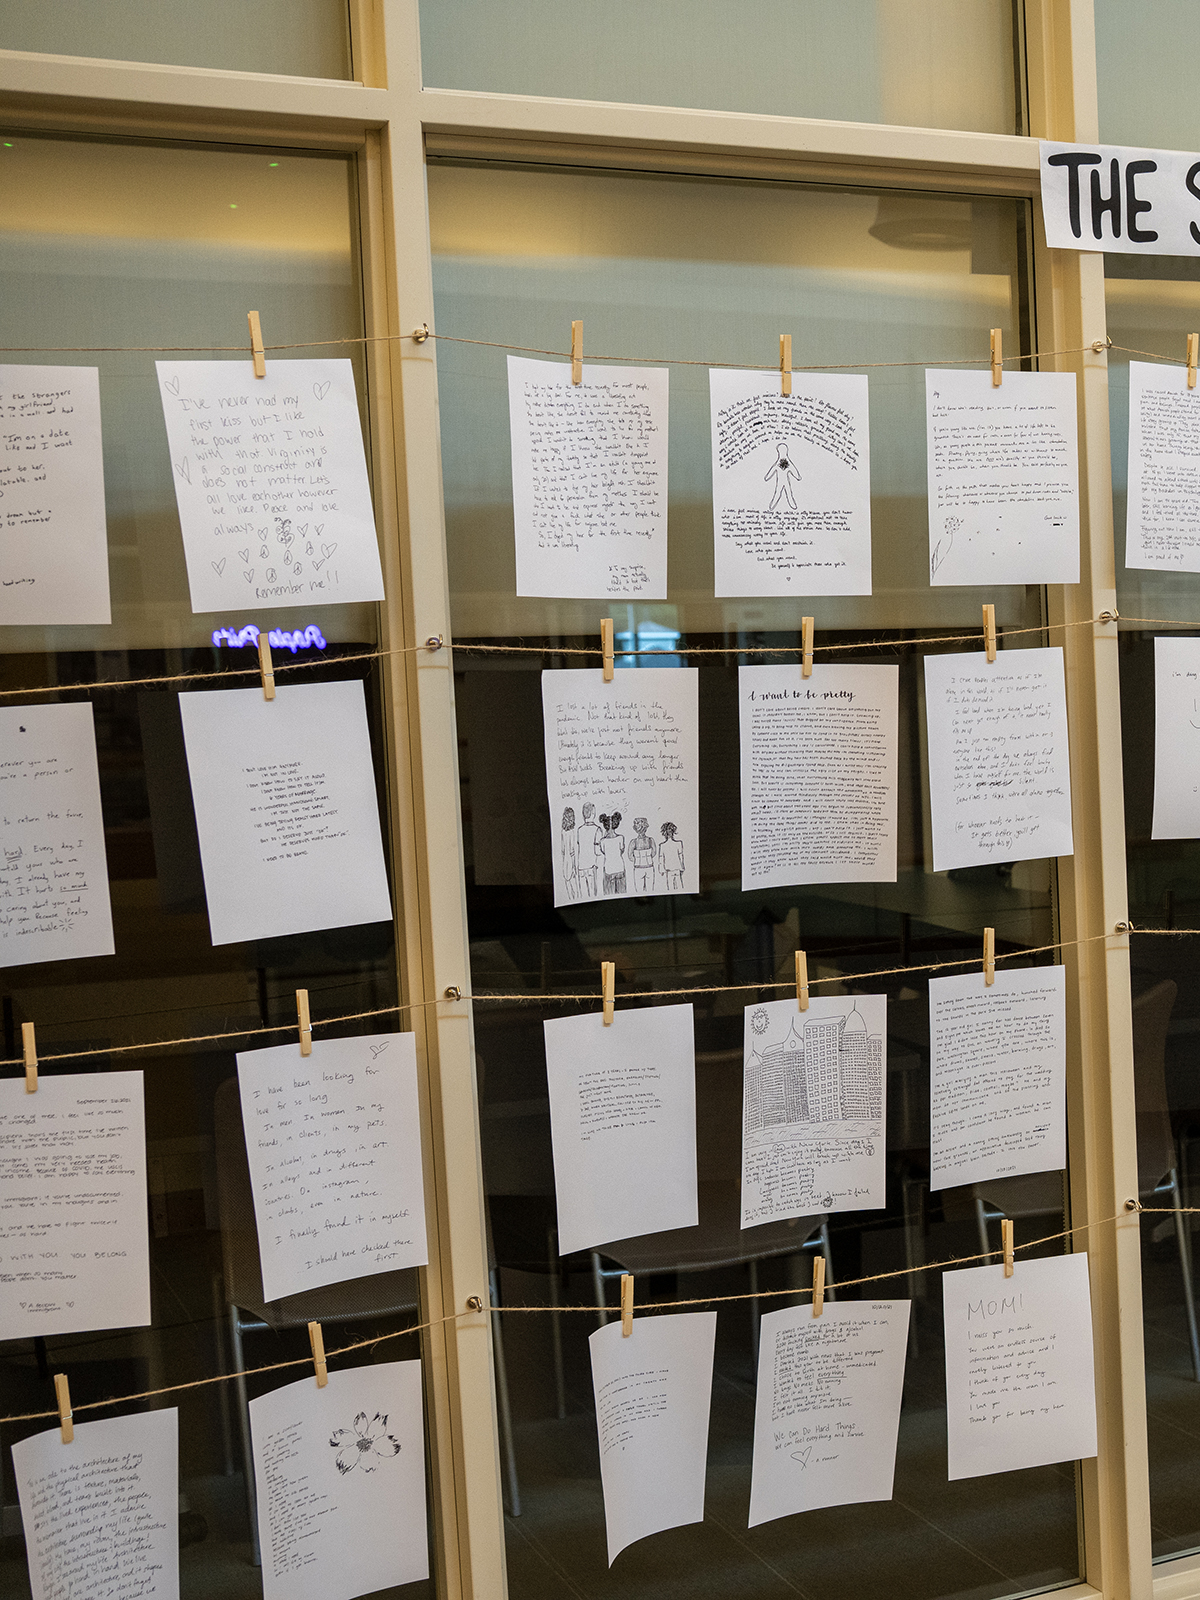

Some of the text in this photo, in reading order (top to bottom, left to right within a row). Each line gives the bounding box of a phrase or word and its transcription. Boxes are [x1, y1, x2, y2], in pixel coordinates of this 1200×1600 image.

[1047, 152, 1159, 243] THE
[178, 399, 211, 411] I've
[218, 396, 249, 409] never
[283, 396, 299, 408] my
[190, 411, 305, 431] first kiss but I like
[49, 430, 70, 438] date
[191, 435, 208, 446] the
[213, 435, 241, 448] power
[252, 433, 275, 443] that
[283, 430, 293, 440] I
[42, 442, 49, 450] I
[54, 440, 73, 448] want
[196, 448, 223, 460] with
[320, 446, 327, 454] is
[220, 465, 246, 476] social
[254, 461, 297, 473] construct
[305, 458, 322, 468] and
[202, 476, 226, 488] does
[236, 476, 256, 488] not
[310, 475, 330, 485] Let's
[207, 494, 220, 504] all
[227, 492, 246, 504] love
[298, 489, 338, 498] however
[212, 506, 225, 514] we
[263, 503, 288, 513] Peace
[297, 502, 314, 512] and
[322, 502, 339, 511] love
[214, 522, 254, 536] always
[256, 580, 304, 598] Remember
[760, 689, 789, 700] want
[804, 690, 817, 699] be
[820, 691, 856, 702] pretty
[603, 703, 610, 712] of
[615, 701, 637, 709] friends
[628, 725, 651, 735] friends
[34, 770, 58, 779] person
[663, 762, 683, 774] friends
[4, 817, 10, 825] to
[47, 811, 59, 819] the
[34, 840, 83, 853] Every I
[17, 887, 30, 896] It
[253, 1090, 260, 1098] I
[294, 1079, 311, 1088] been
[323, 1072, 354, 1084] looking
[365, 1066, 380, 1075] for
[277, 1101, 286, 1110] for
[264, 1123, 273, 1131] In
[321, 1109, 345, 1117] women
[348, 1124, 360, 1133] my
[323, 1148, 346, 1158] drugs
[309, 1167, 321, 1176] and
[275, 1236, 282, 1245] I
[289, 1226, 320, 1239] finally
[324, 1216, 350, 1229] found
[355, 1215, 364, 1224] it
[94, 1251, 127, 1259] BELONG
[316, 1238, 413, 1265] should have checked there
[374, 1252, 399, 1263] first
[968, 1293, 1024, 1320] MOM!
[992, 1330, 1002, 1339] you
[1003, 1375, 1011, 1383] you
[992, 1415, 1001, 1423] you
[774, 1431, 785, 1441] We
[803, 1427, 811, 1435] Do
[816, 1424, 829, 1433] Hard
[835, 1422, 856, 1433] Things
